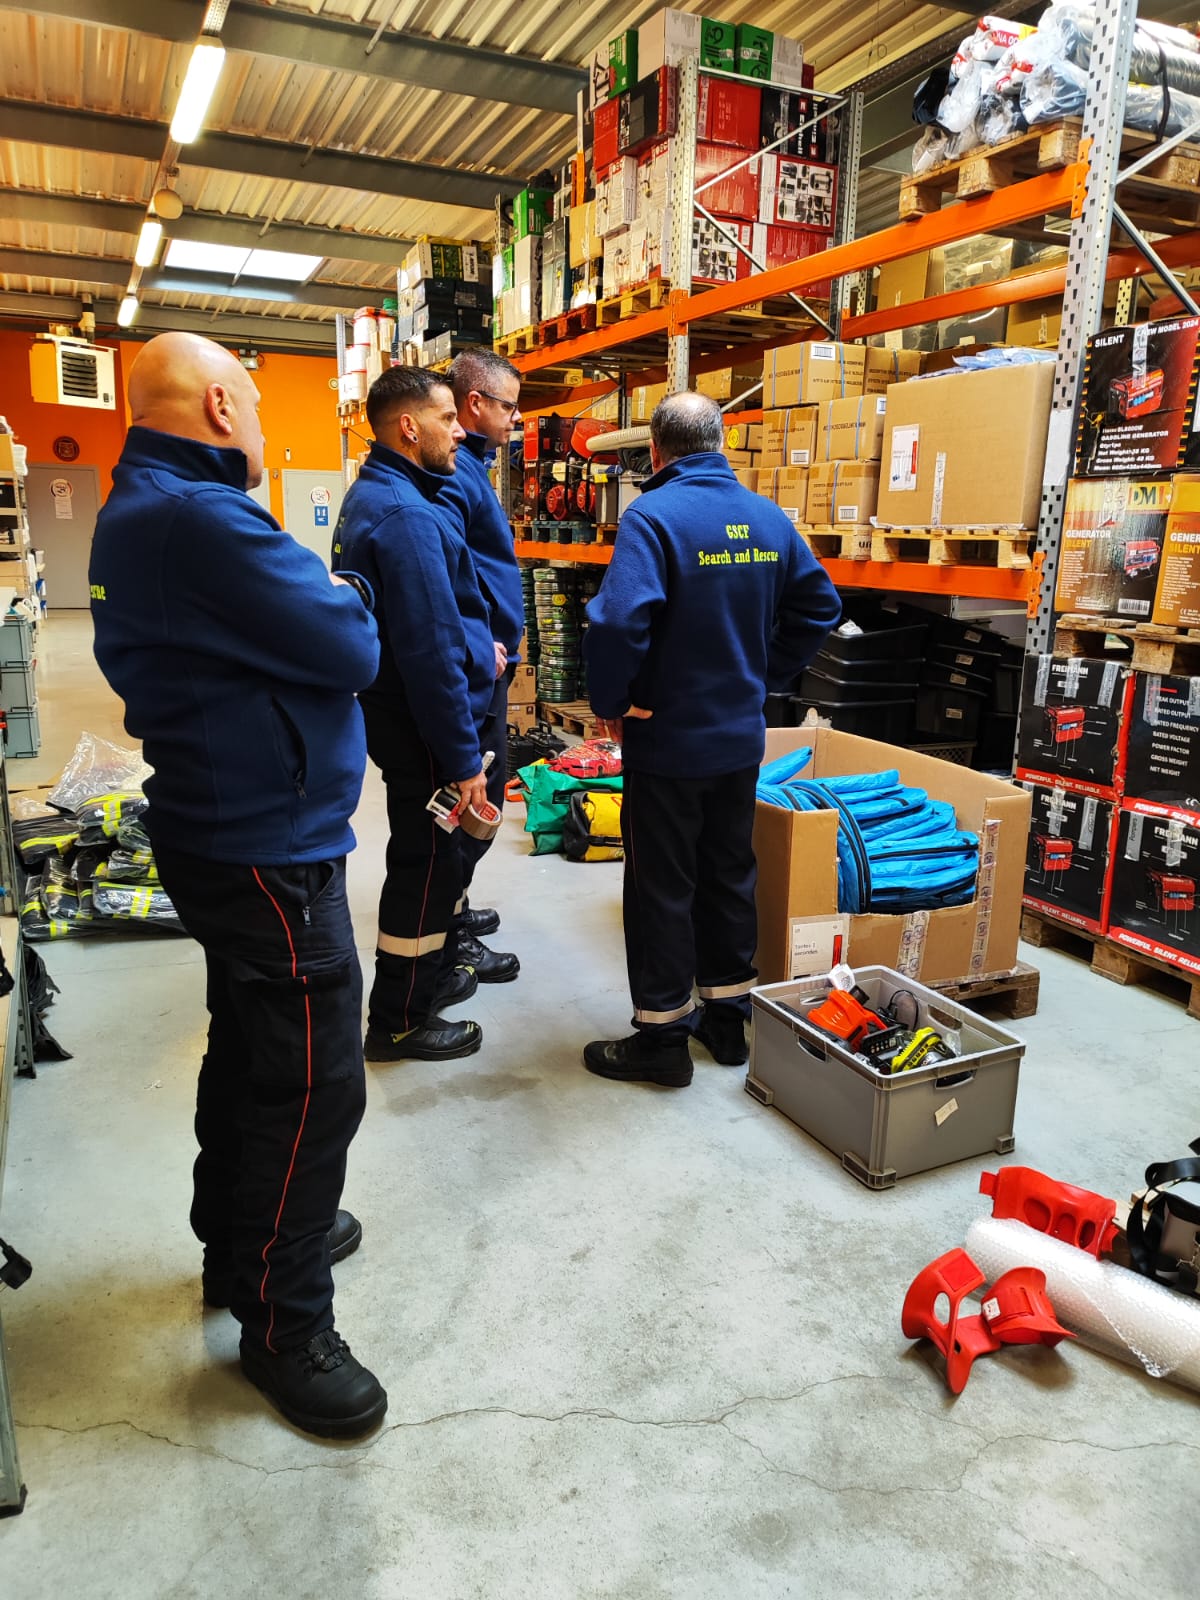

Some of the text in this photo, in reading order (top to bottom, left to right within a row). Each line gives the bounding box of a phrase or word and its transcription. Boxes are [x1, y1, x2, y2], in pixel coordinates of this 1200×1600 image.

[1158, 323, 1182, 335] MODEL
[1182, 319, 1199, 329] 2024
[1095, 334, 1125, 348] SILENT
[725, 524, 750, 539] GSCF
[1066, 529, 1111, 539] GENERATOR
[698, 548, 779, 566] Search and Rescue
[1170, 710, 1191, 719] OUTPUT
[1170, 721, 1200, 733] FREQUENCY
[1153, 730, 1190, 743] RATED VOLTAGE
[1170, 745, 1190, 755] FACTOR
[1150, 765, 1160, 773] NET
